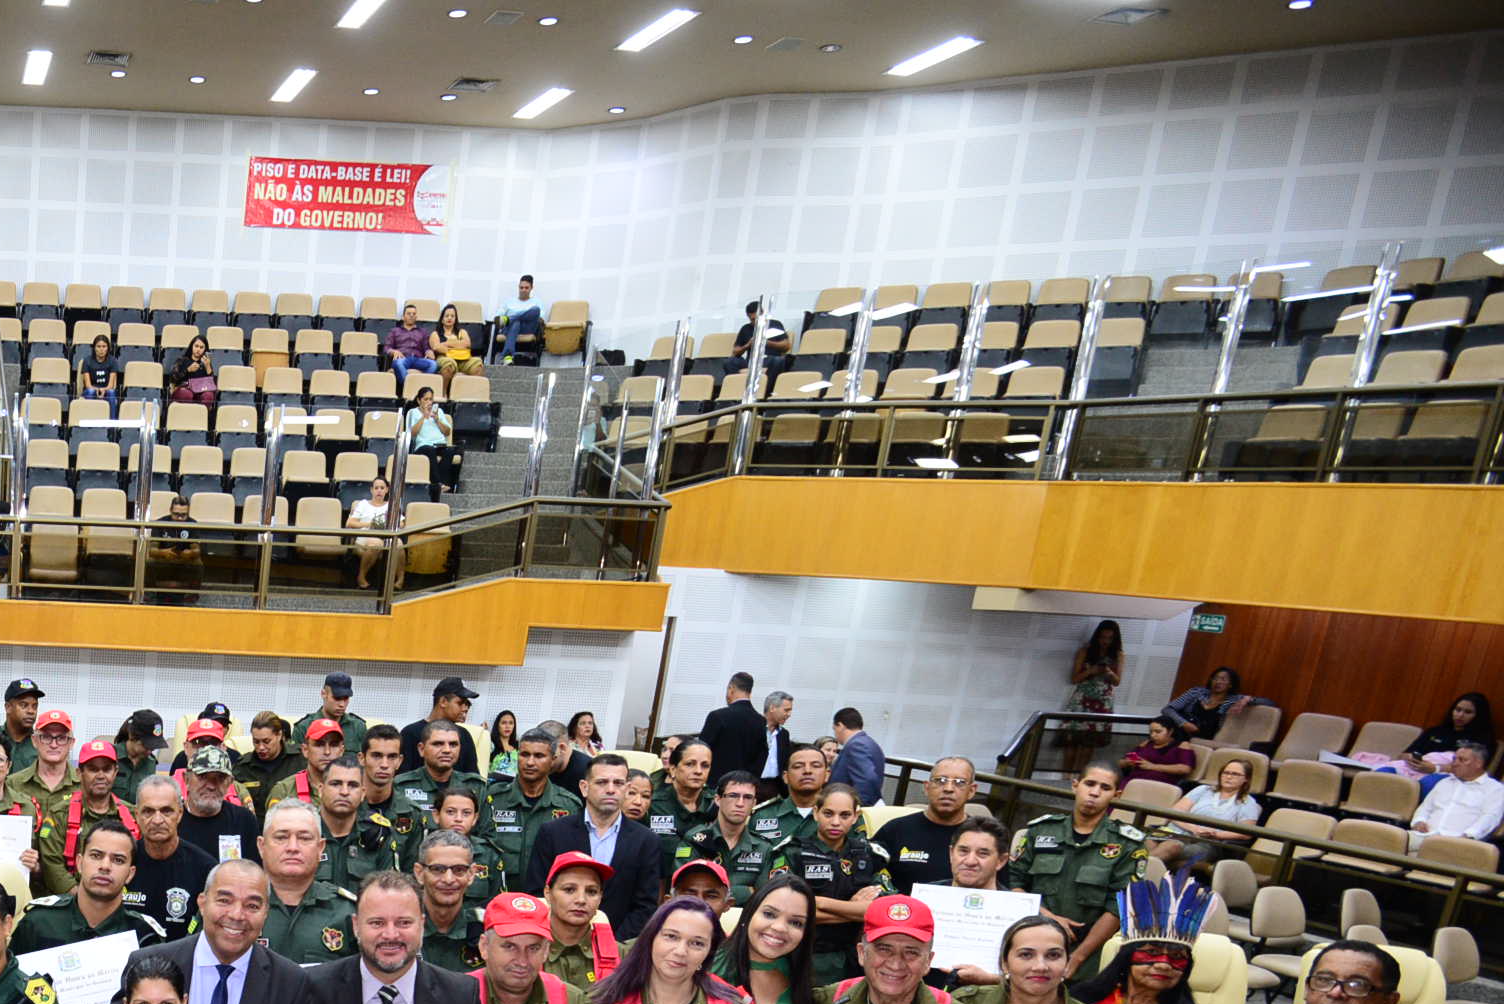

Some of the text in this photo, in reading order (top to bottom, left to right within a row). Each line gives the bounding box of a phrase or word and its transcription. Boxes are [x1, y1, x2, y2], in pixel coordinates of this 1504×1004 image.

[253, 163, 411, 183] PISO E DATA-BASE É LEI!
[254, 180, 406, 206] NÃO ÀS MALDADES
[273, 208, 383, 229] DO GOVERNO!
